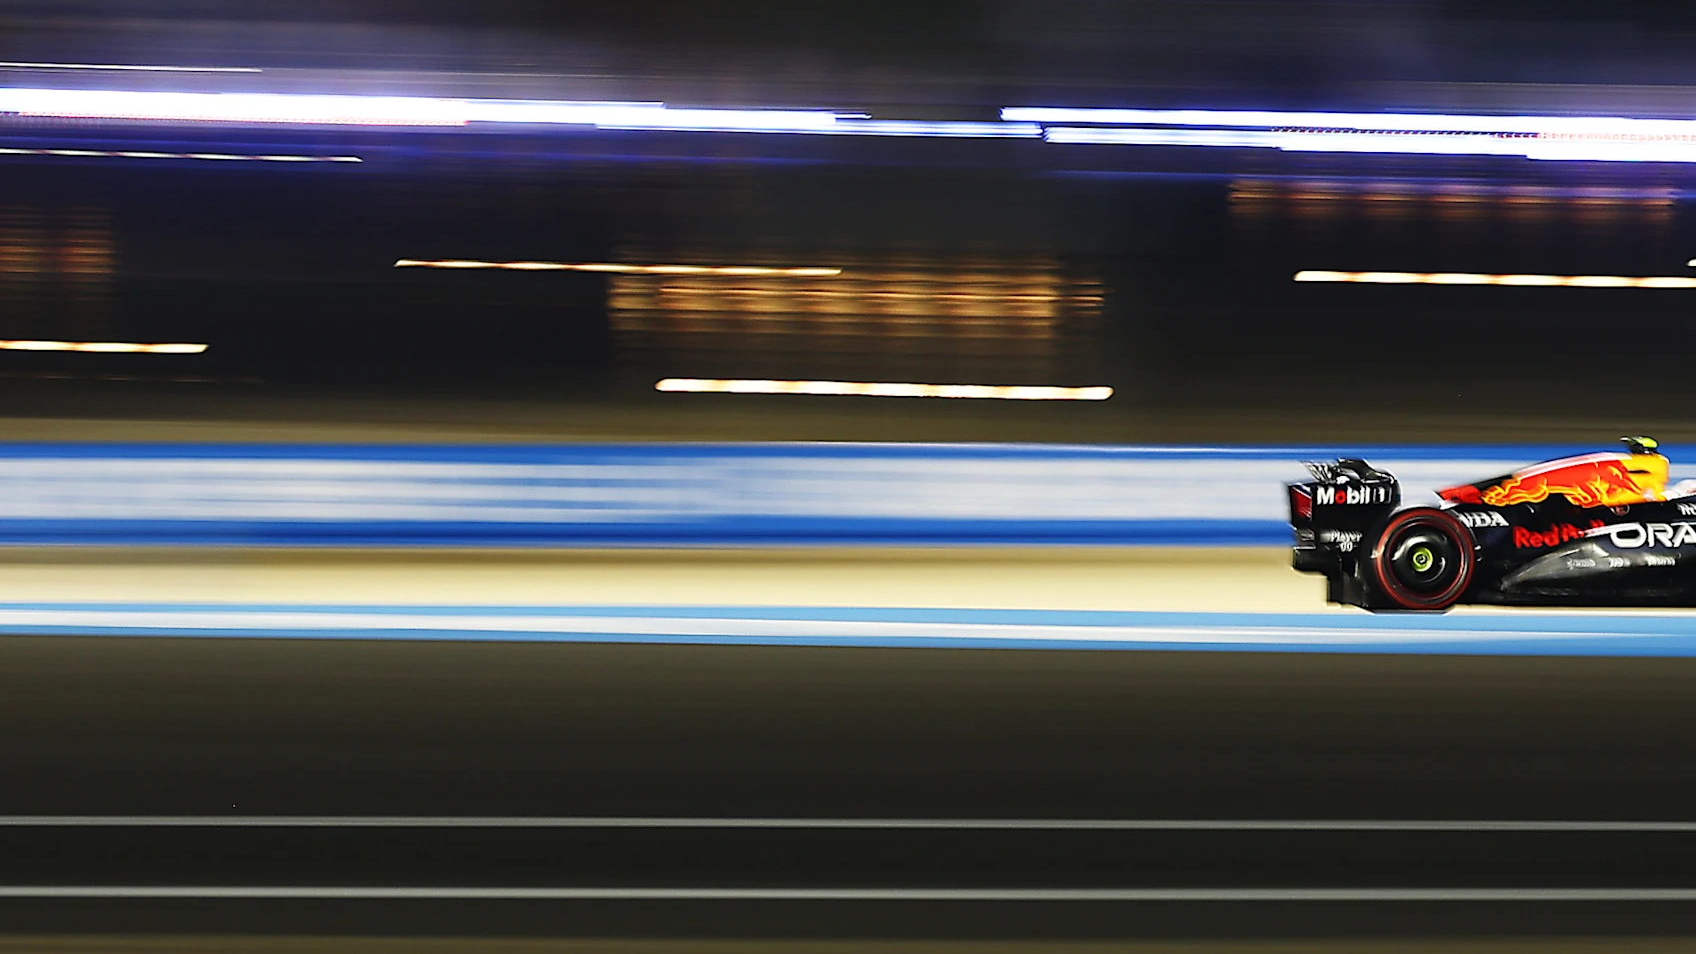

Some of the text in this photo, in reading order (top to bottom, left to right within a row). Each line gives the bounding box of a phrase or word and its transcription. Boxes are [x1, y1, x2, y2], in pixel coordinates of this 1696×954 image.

[1316, 485, 1371, 505] Mobil
[1458, 511, 1510, 528] NDA
[1513, 525, 1560, 549] Red
